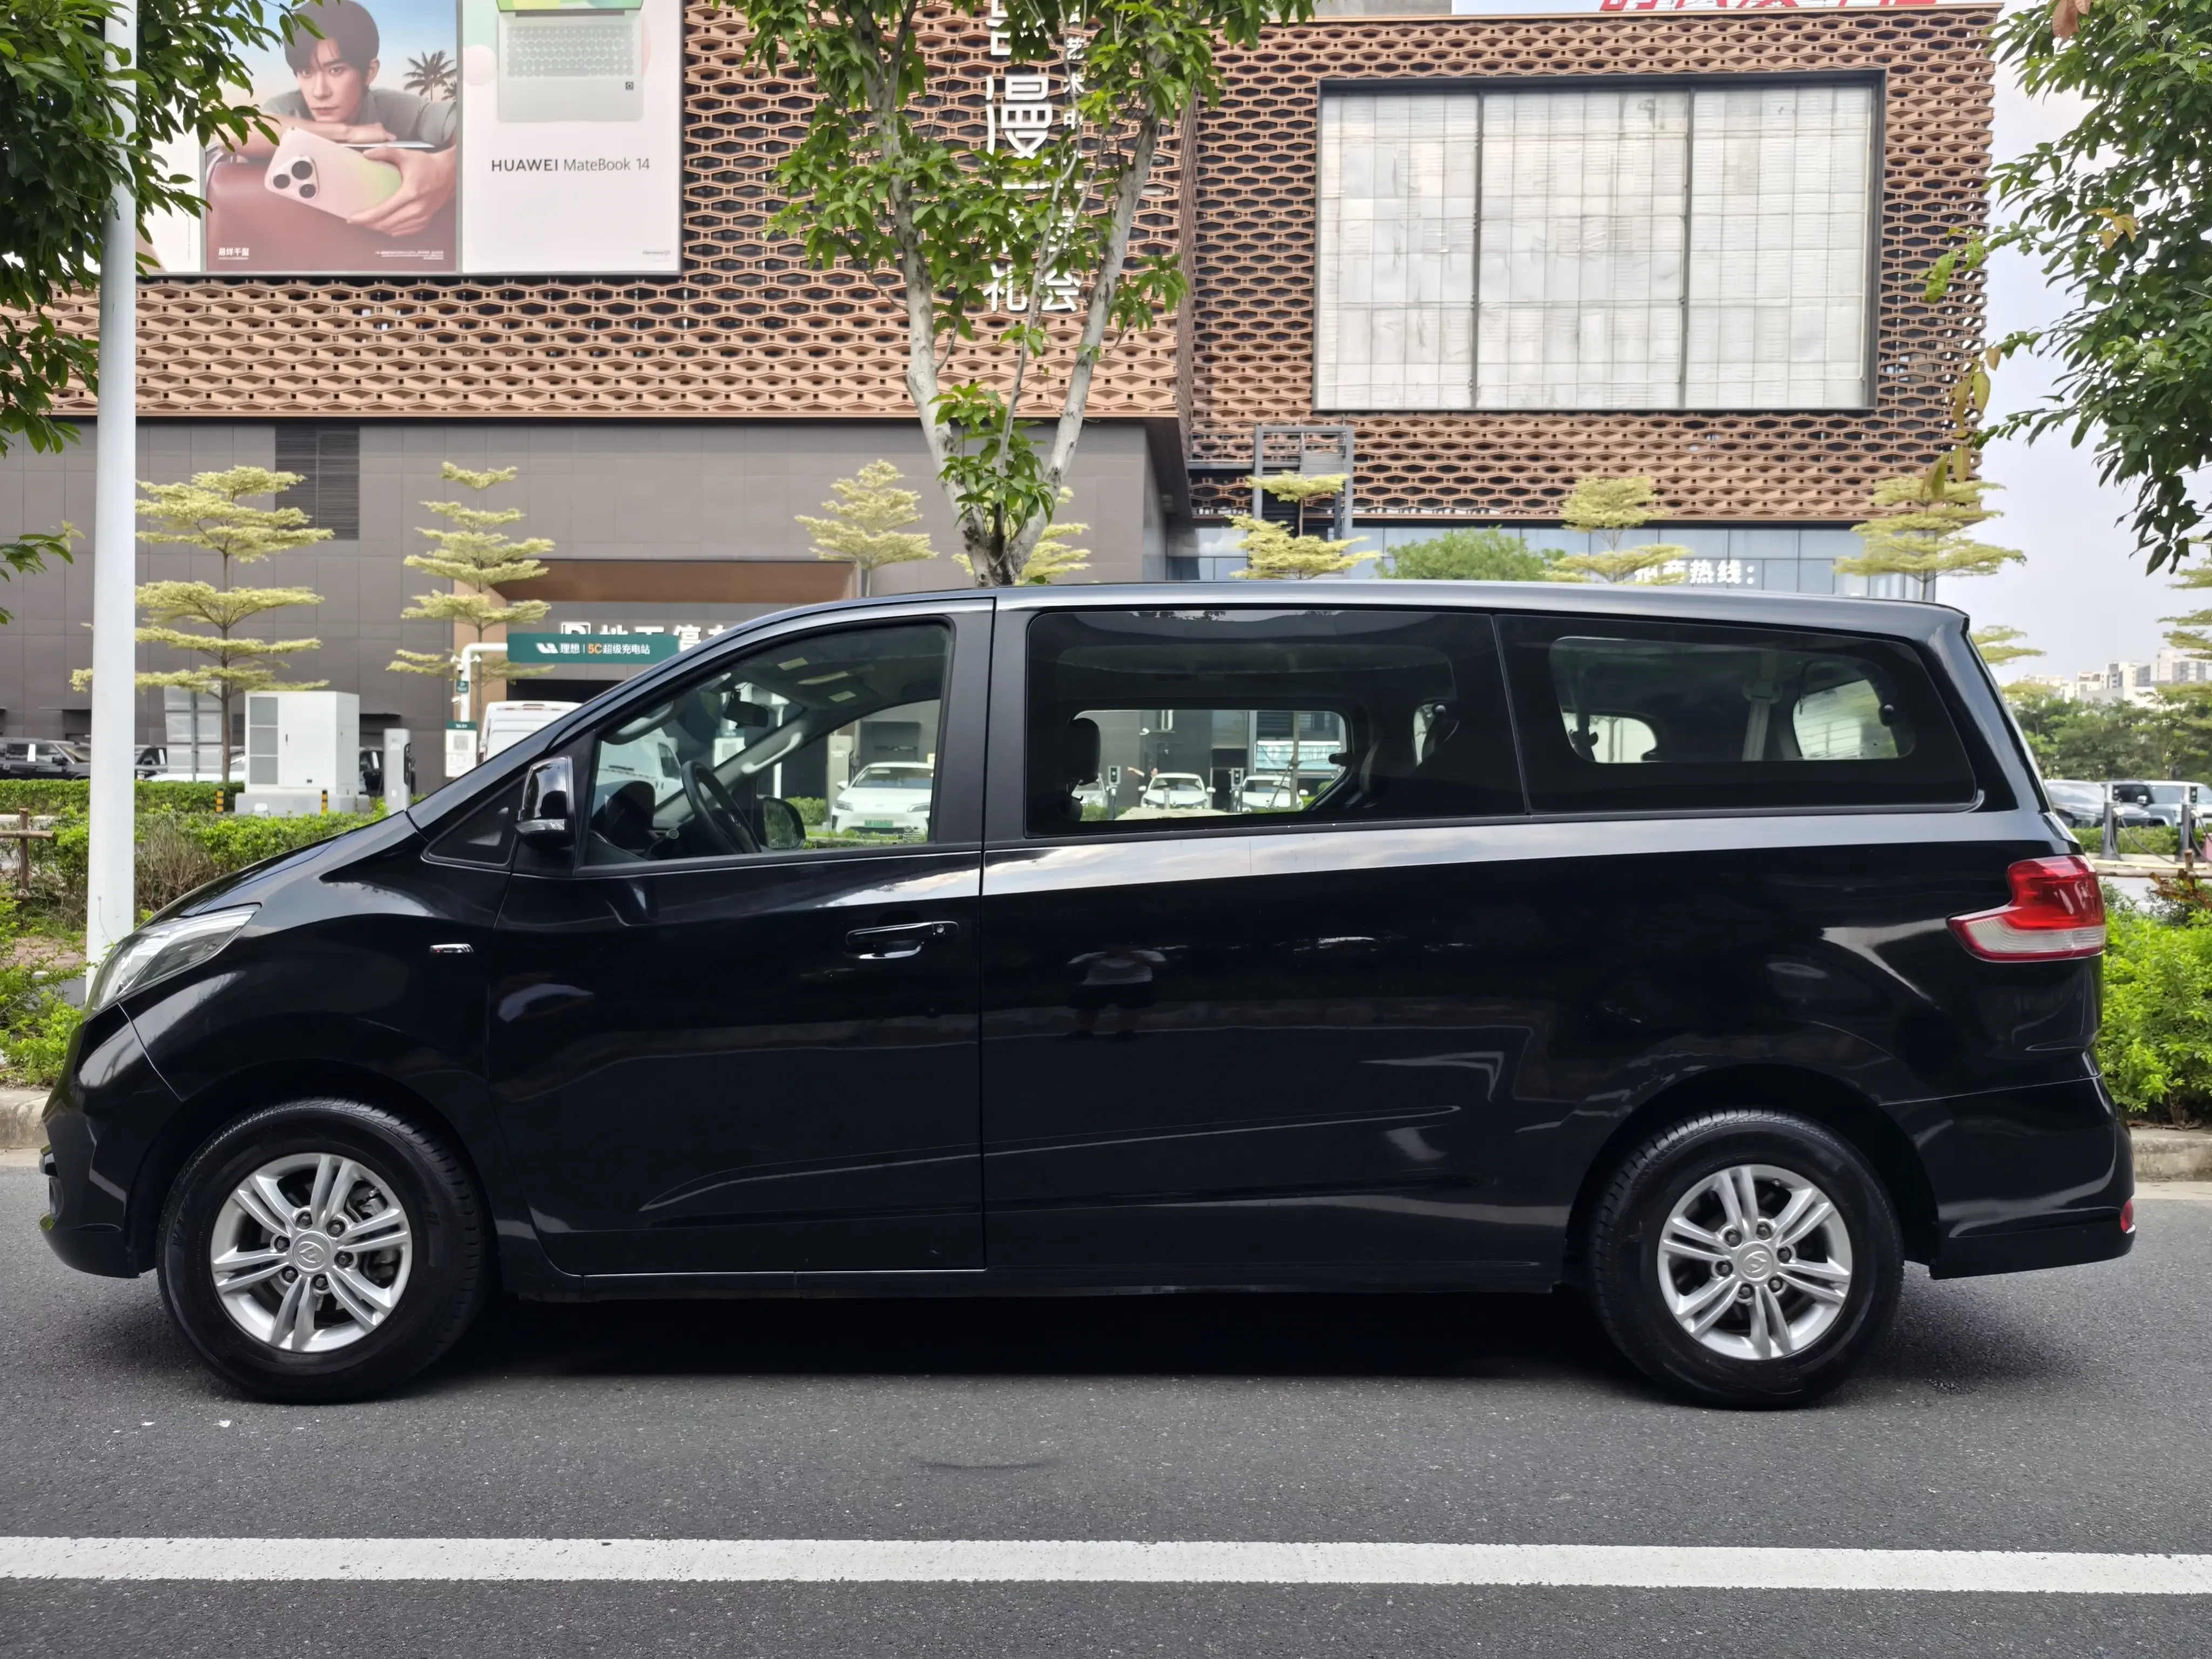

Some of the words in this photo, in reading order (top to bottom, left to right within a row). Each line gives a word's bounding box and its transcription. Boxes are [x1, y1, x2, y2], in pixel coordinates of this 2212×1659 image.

[491, 159, 558, 172] HUAWEI
[563, 158, 631, 171] MateBook
[636, 158, 650, 171] 14
[560, 643, 581, 654] 理想
